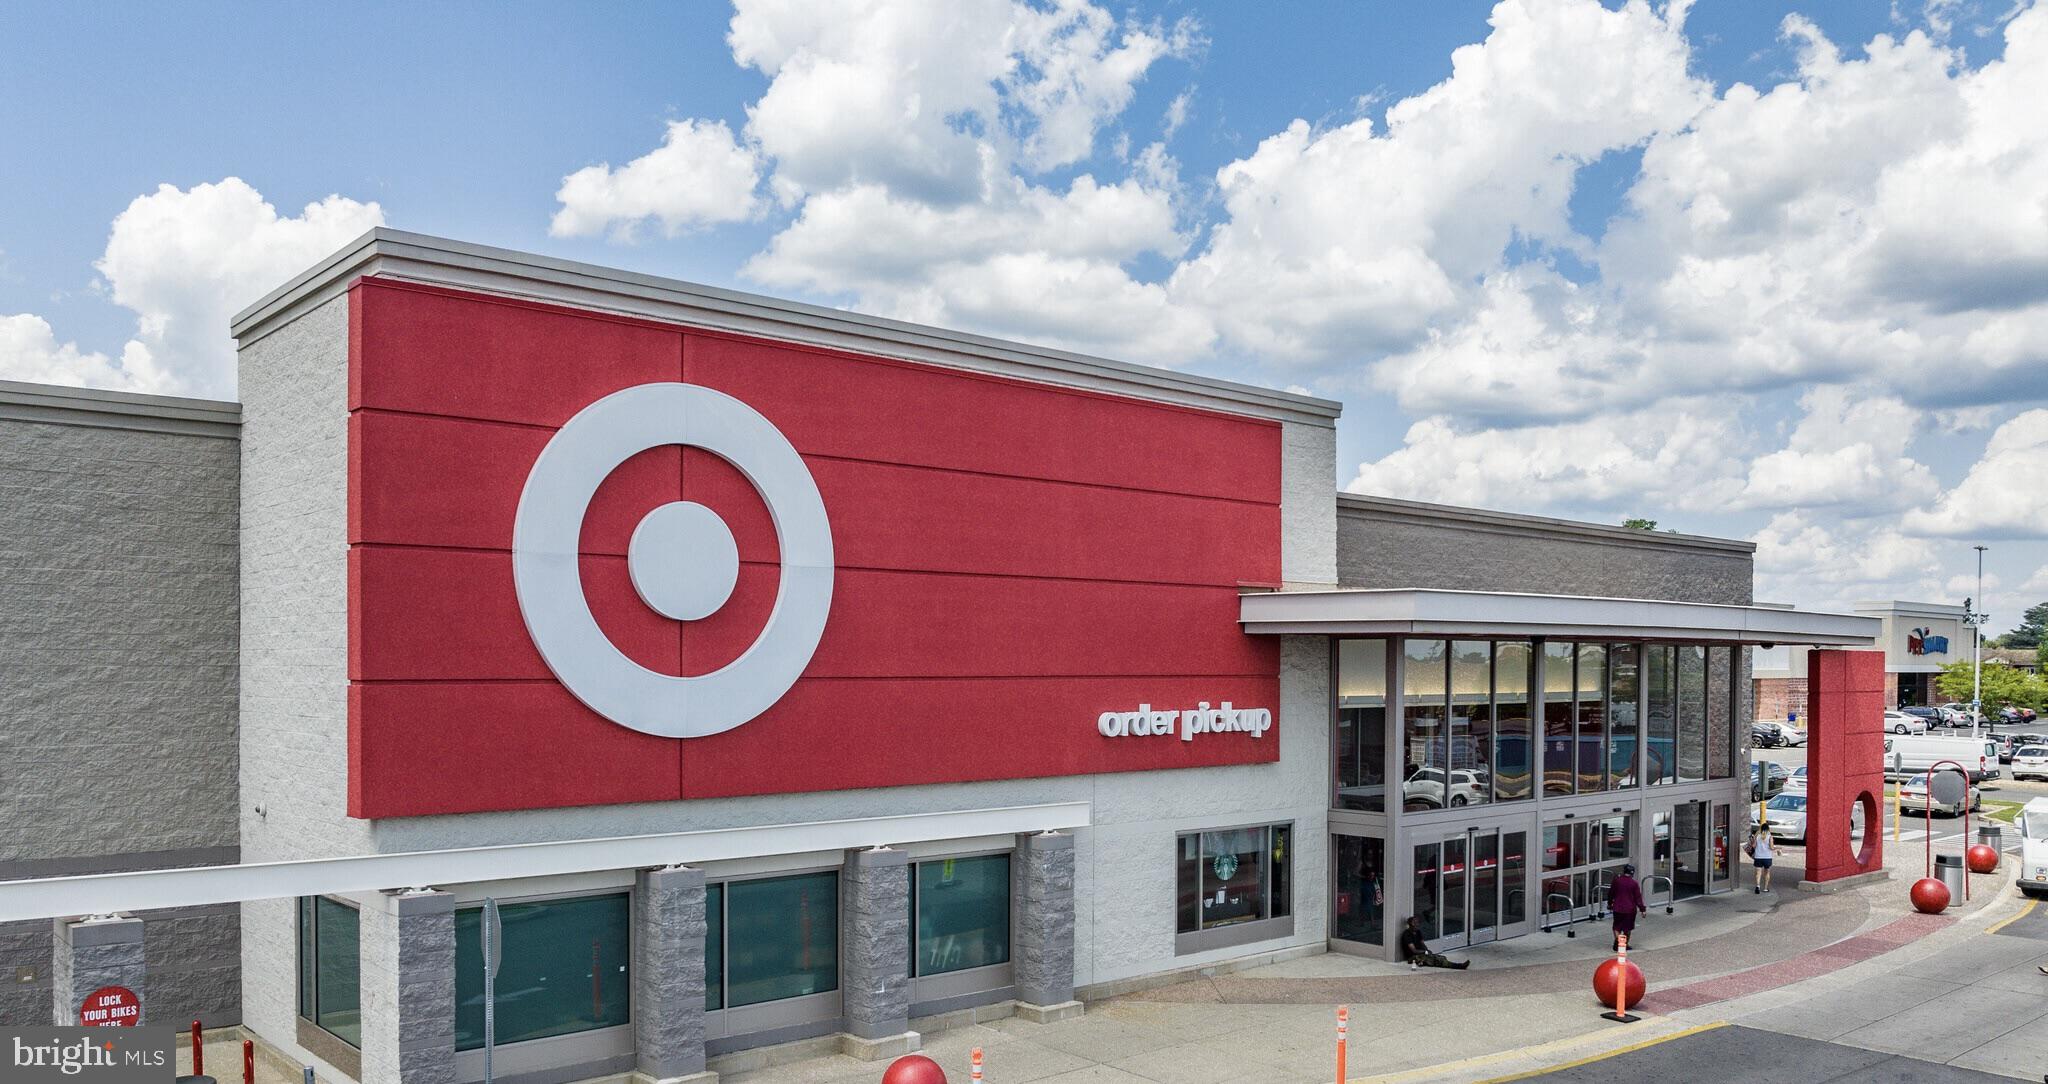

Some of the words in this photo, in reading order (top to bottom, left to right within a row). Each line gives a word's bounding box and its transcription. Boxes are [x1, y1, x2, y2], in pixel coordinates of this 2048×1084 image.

[1098, 703, 1179, 737] order
[1181, 701, 1272, 741] pickup
[99, 994, 122, 1007] LOCK
[83, 1009, 108, 1021] YOUR
[111, 1005, 137, 1018] BIKES
